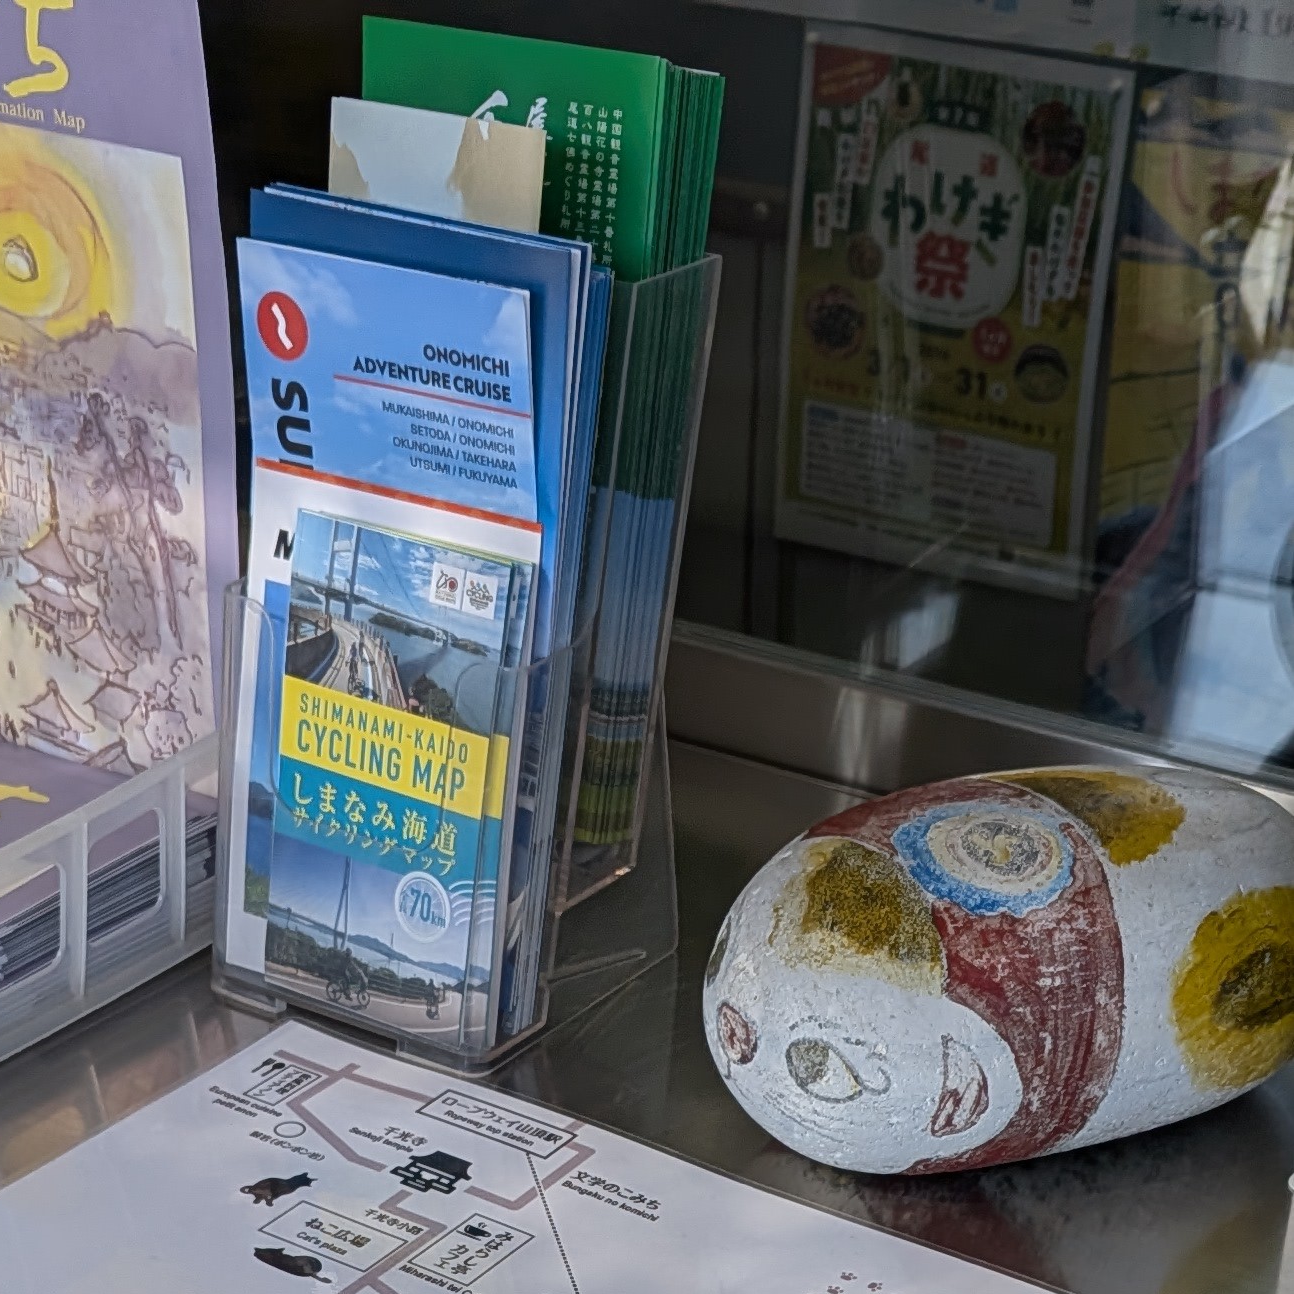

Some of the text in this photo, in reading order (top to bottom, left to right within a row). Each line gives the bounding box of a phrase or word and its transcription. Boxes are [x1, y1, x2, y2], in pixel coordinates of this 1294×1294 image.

[54, 109, 86, 132] Map
[915, 231, 970, 300] 祭
[353, 356, 512, 403] ADVENTURE CRUISE
[423, 343, 510, 377] ONOMICHI
[381, 400, 514, 439] MUKAISHIMA ONOMICHI
[392, 436, 517, 473] OKUNOJIMA TAKEHARA
[410, 424, 515, 456] SETODA ONOMICHI
[409, 456, 518, 489] UTSUMI FUKUYAMA
[299, 692, 469, 764] SHIMANAMI-KAIDO
[297, 719, 466, 802] CYCLING MAP
[293, 772, 458, 857] しまなみ海道
[292, 806, 457, 876] サイクリングマップ
[348, 1126, 414, 1154] Senkoji temple
[381, 1124, 428, 1148] 千光寺
[441, 1097, 564, 1145] ロープウェイ山頂駅
[444, 1109, 535, 1147] Ropeway top station
[562, 1180, 660, 1223] Bungaku no komichi
[569, 1170, 661, 1211] 文学のこみち
[304, 1217, 372, 1248] ねこ広場
[433, 1243, 470, 1269] カフェ
[453, 1230, 516, 1276] みはらし亭
